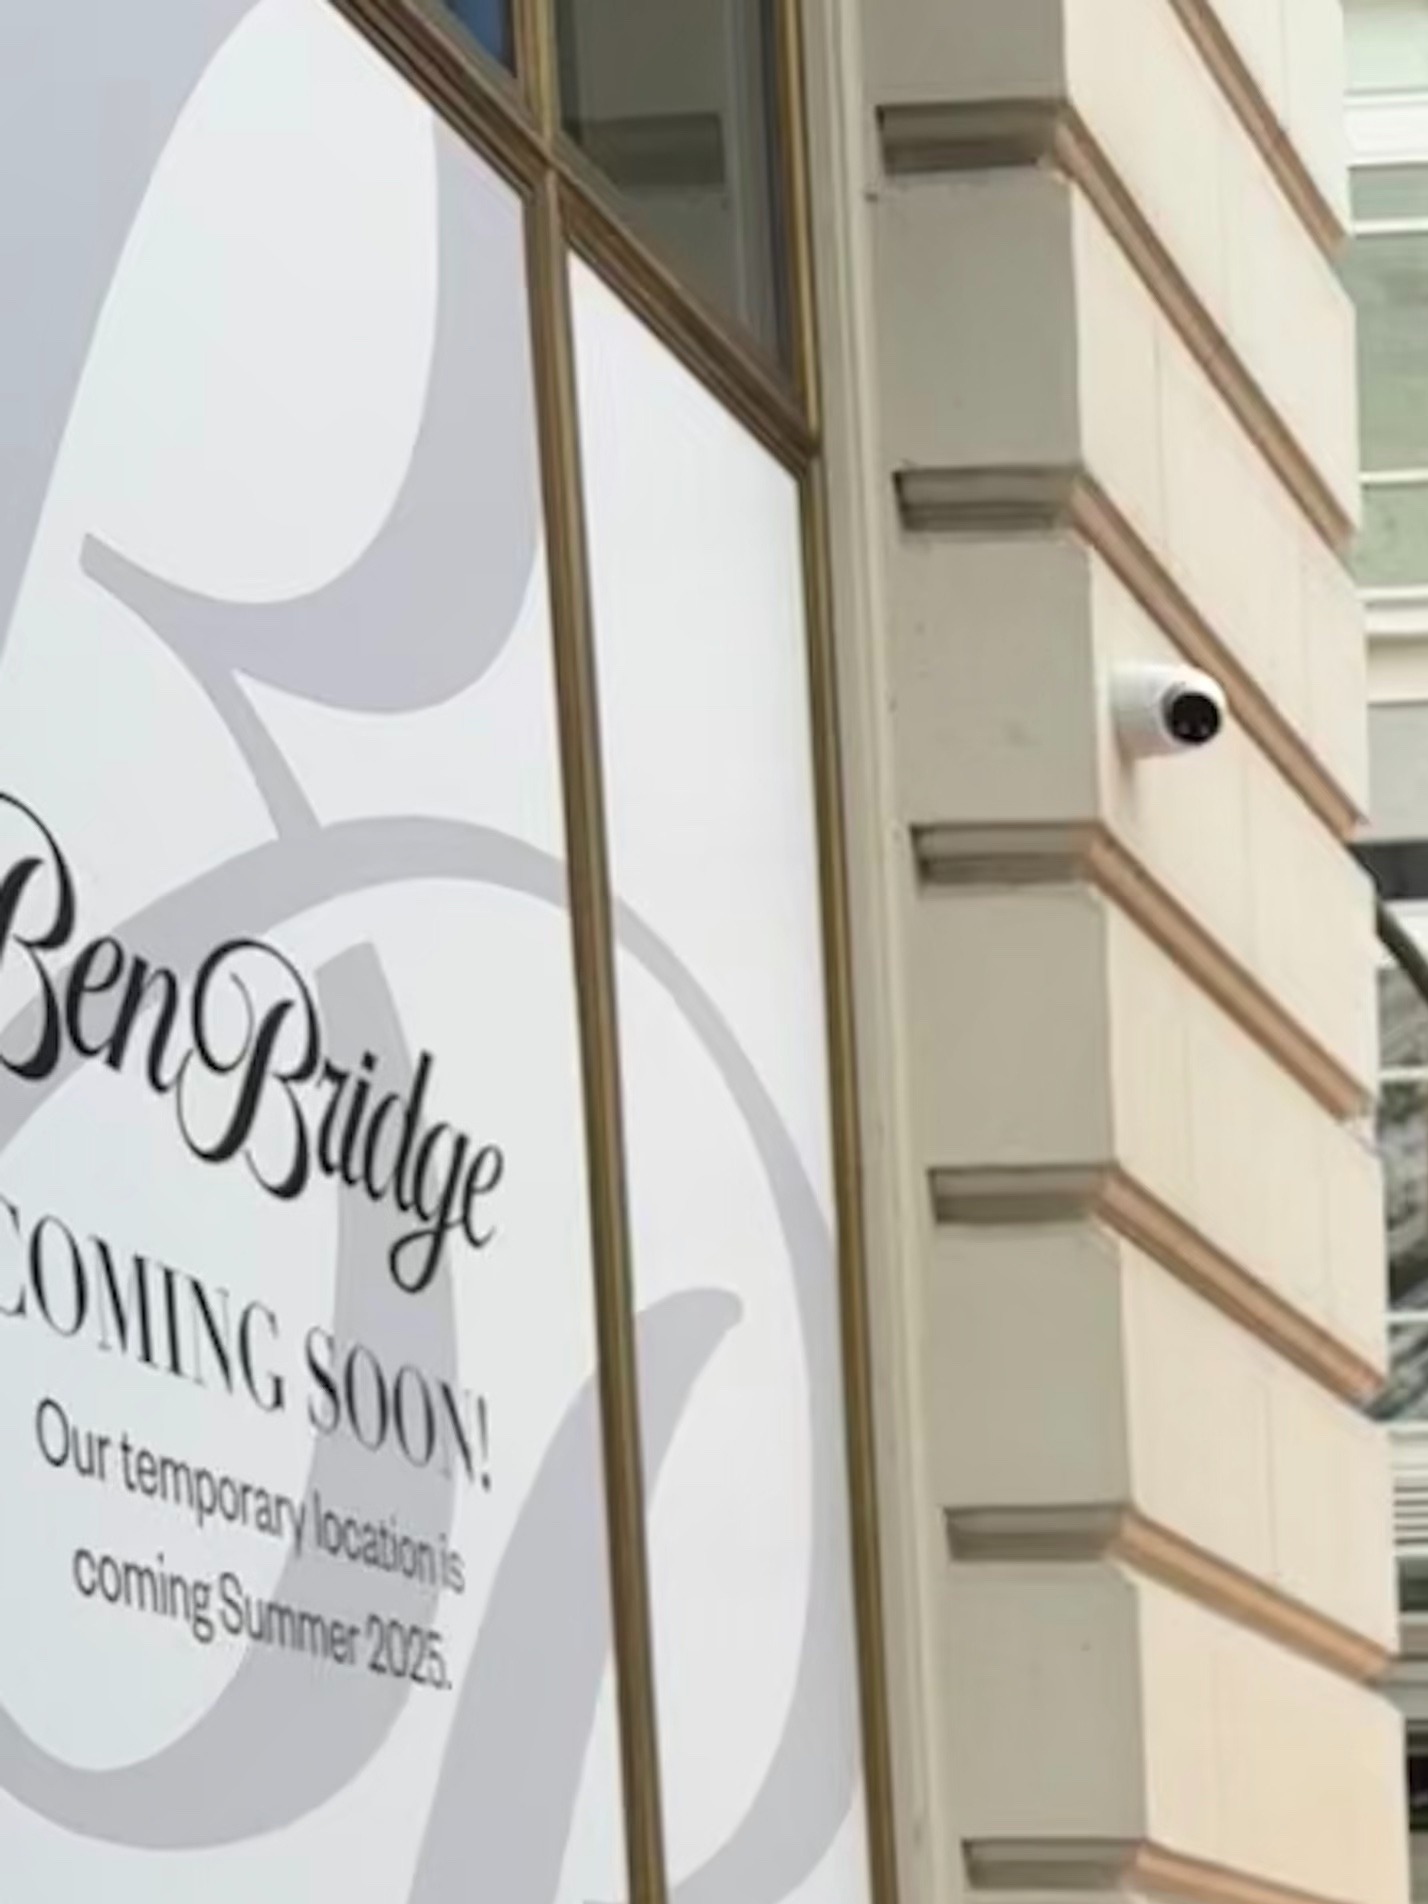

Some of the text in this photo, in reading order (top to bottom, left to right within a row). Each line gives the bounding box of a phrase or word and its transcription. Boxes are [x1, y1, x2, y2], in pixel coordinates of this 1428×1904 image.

[305, 1326, 492, 1493] SOON!
[36, 1397, 467, 1595] Our temporary location is
[73, 1547, 453, 1691] coming Summer 2025.
